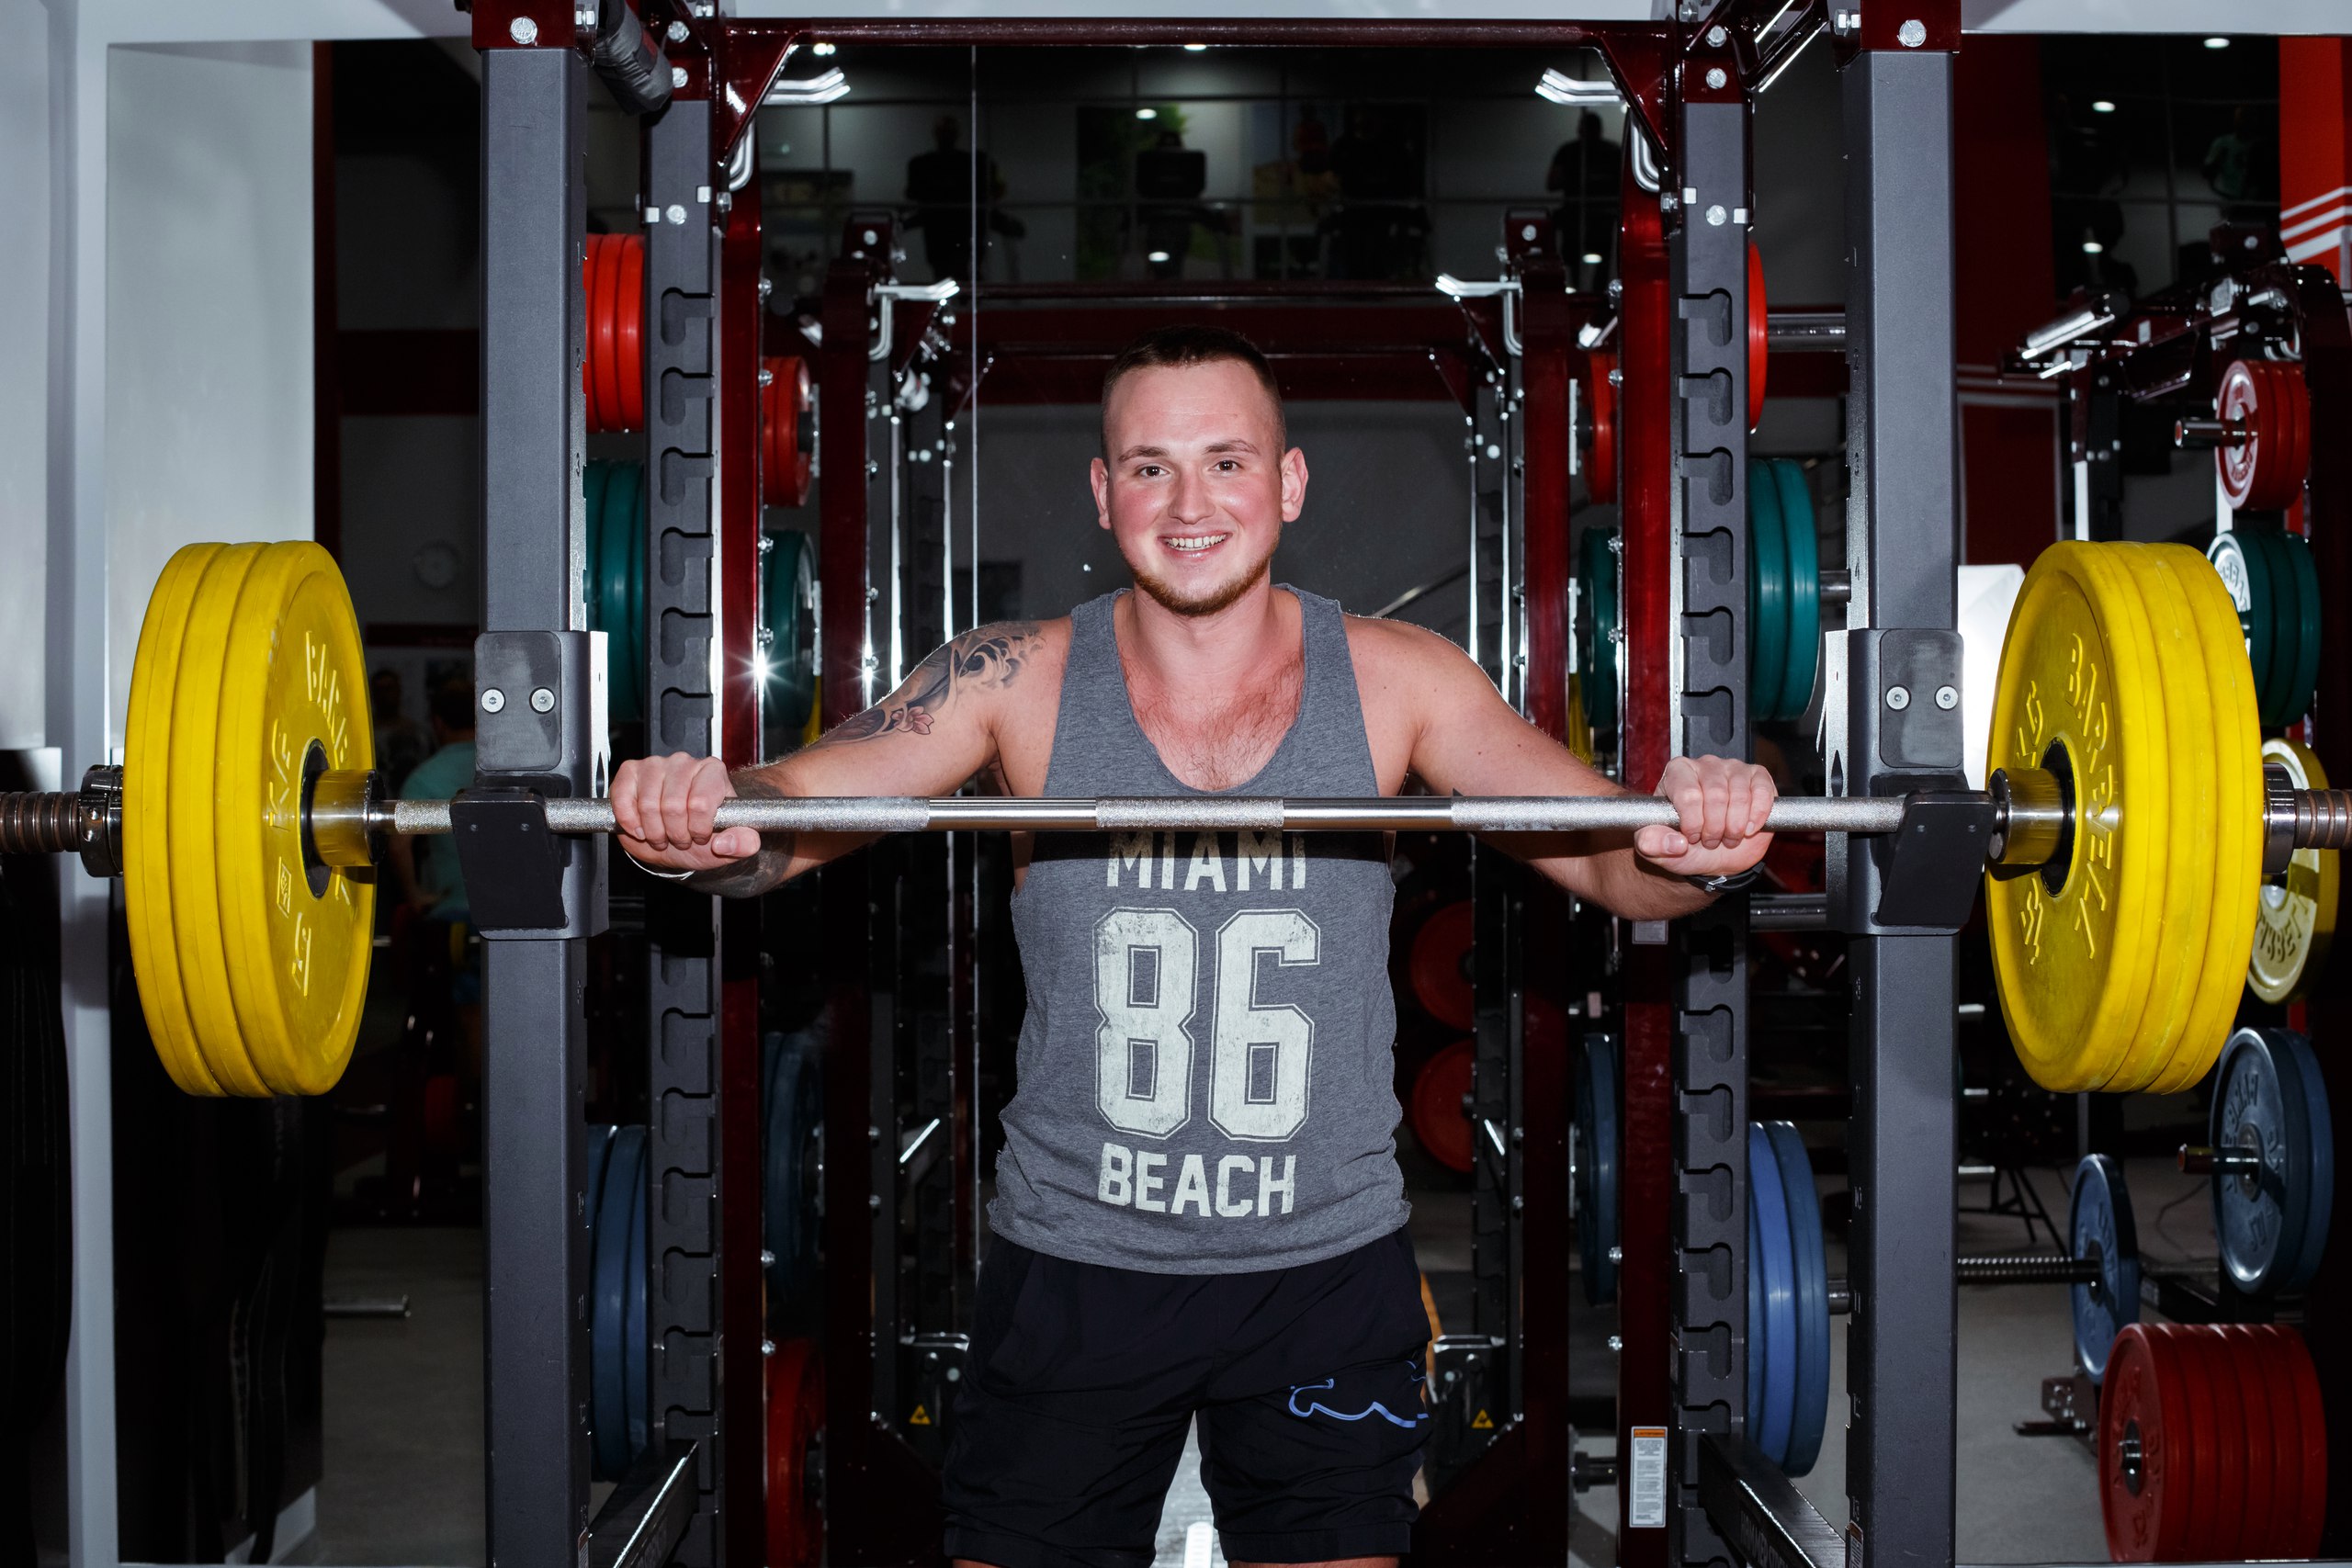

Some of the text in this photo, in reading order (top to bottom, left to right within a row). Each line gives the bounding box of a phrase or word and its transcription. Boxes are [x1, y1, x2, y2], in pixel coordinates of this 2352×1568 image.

[1106, 829, 1306, 892] MIAMI
[2065, 631, 2113, 960] BARBELL
[1091, 906, 1321, 1143] 86
[1097, 1141, 1297, 1218] BEACH
